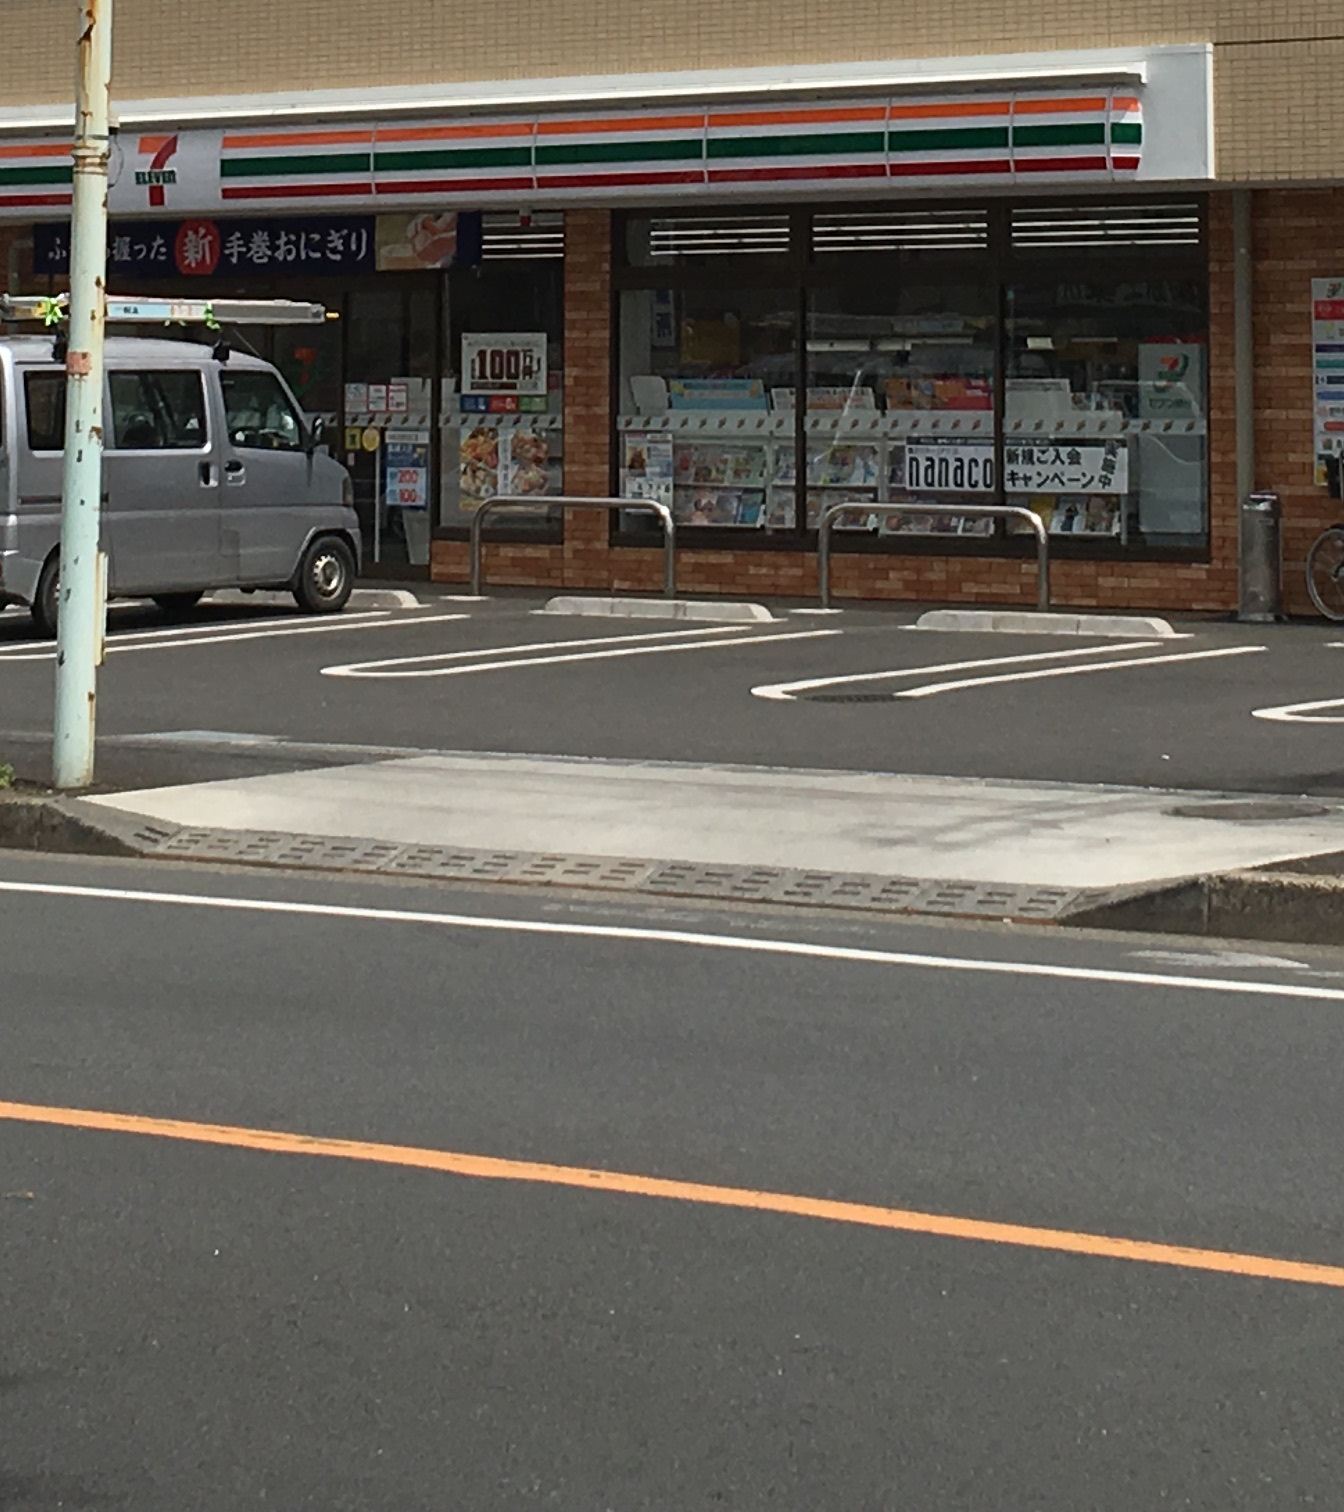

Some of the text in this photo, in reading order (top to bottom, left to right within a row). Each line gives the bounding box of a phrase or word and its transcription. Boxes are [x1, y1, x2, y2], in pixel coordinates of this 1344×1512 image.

[48, 228, 369, 268] ふ握った 新 手巻おにぎり
[1006, 447, 1082, 466] 新規ご入会
[908, 456, 994, 489] nanaco
[1006, 469, 1095, 489] キャンペーン
